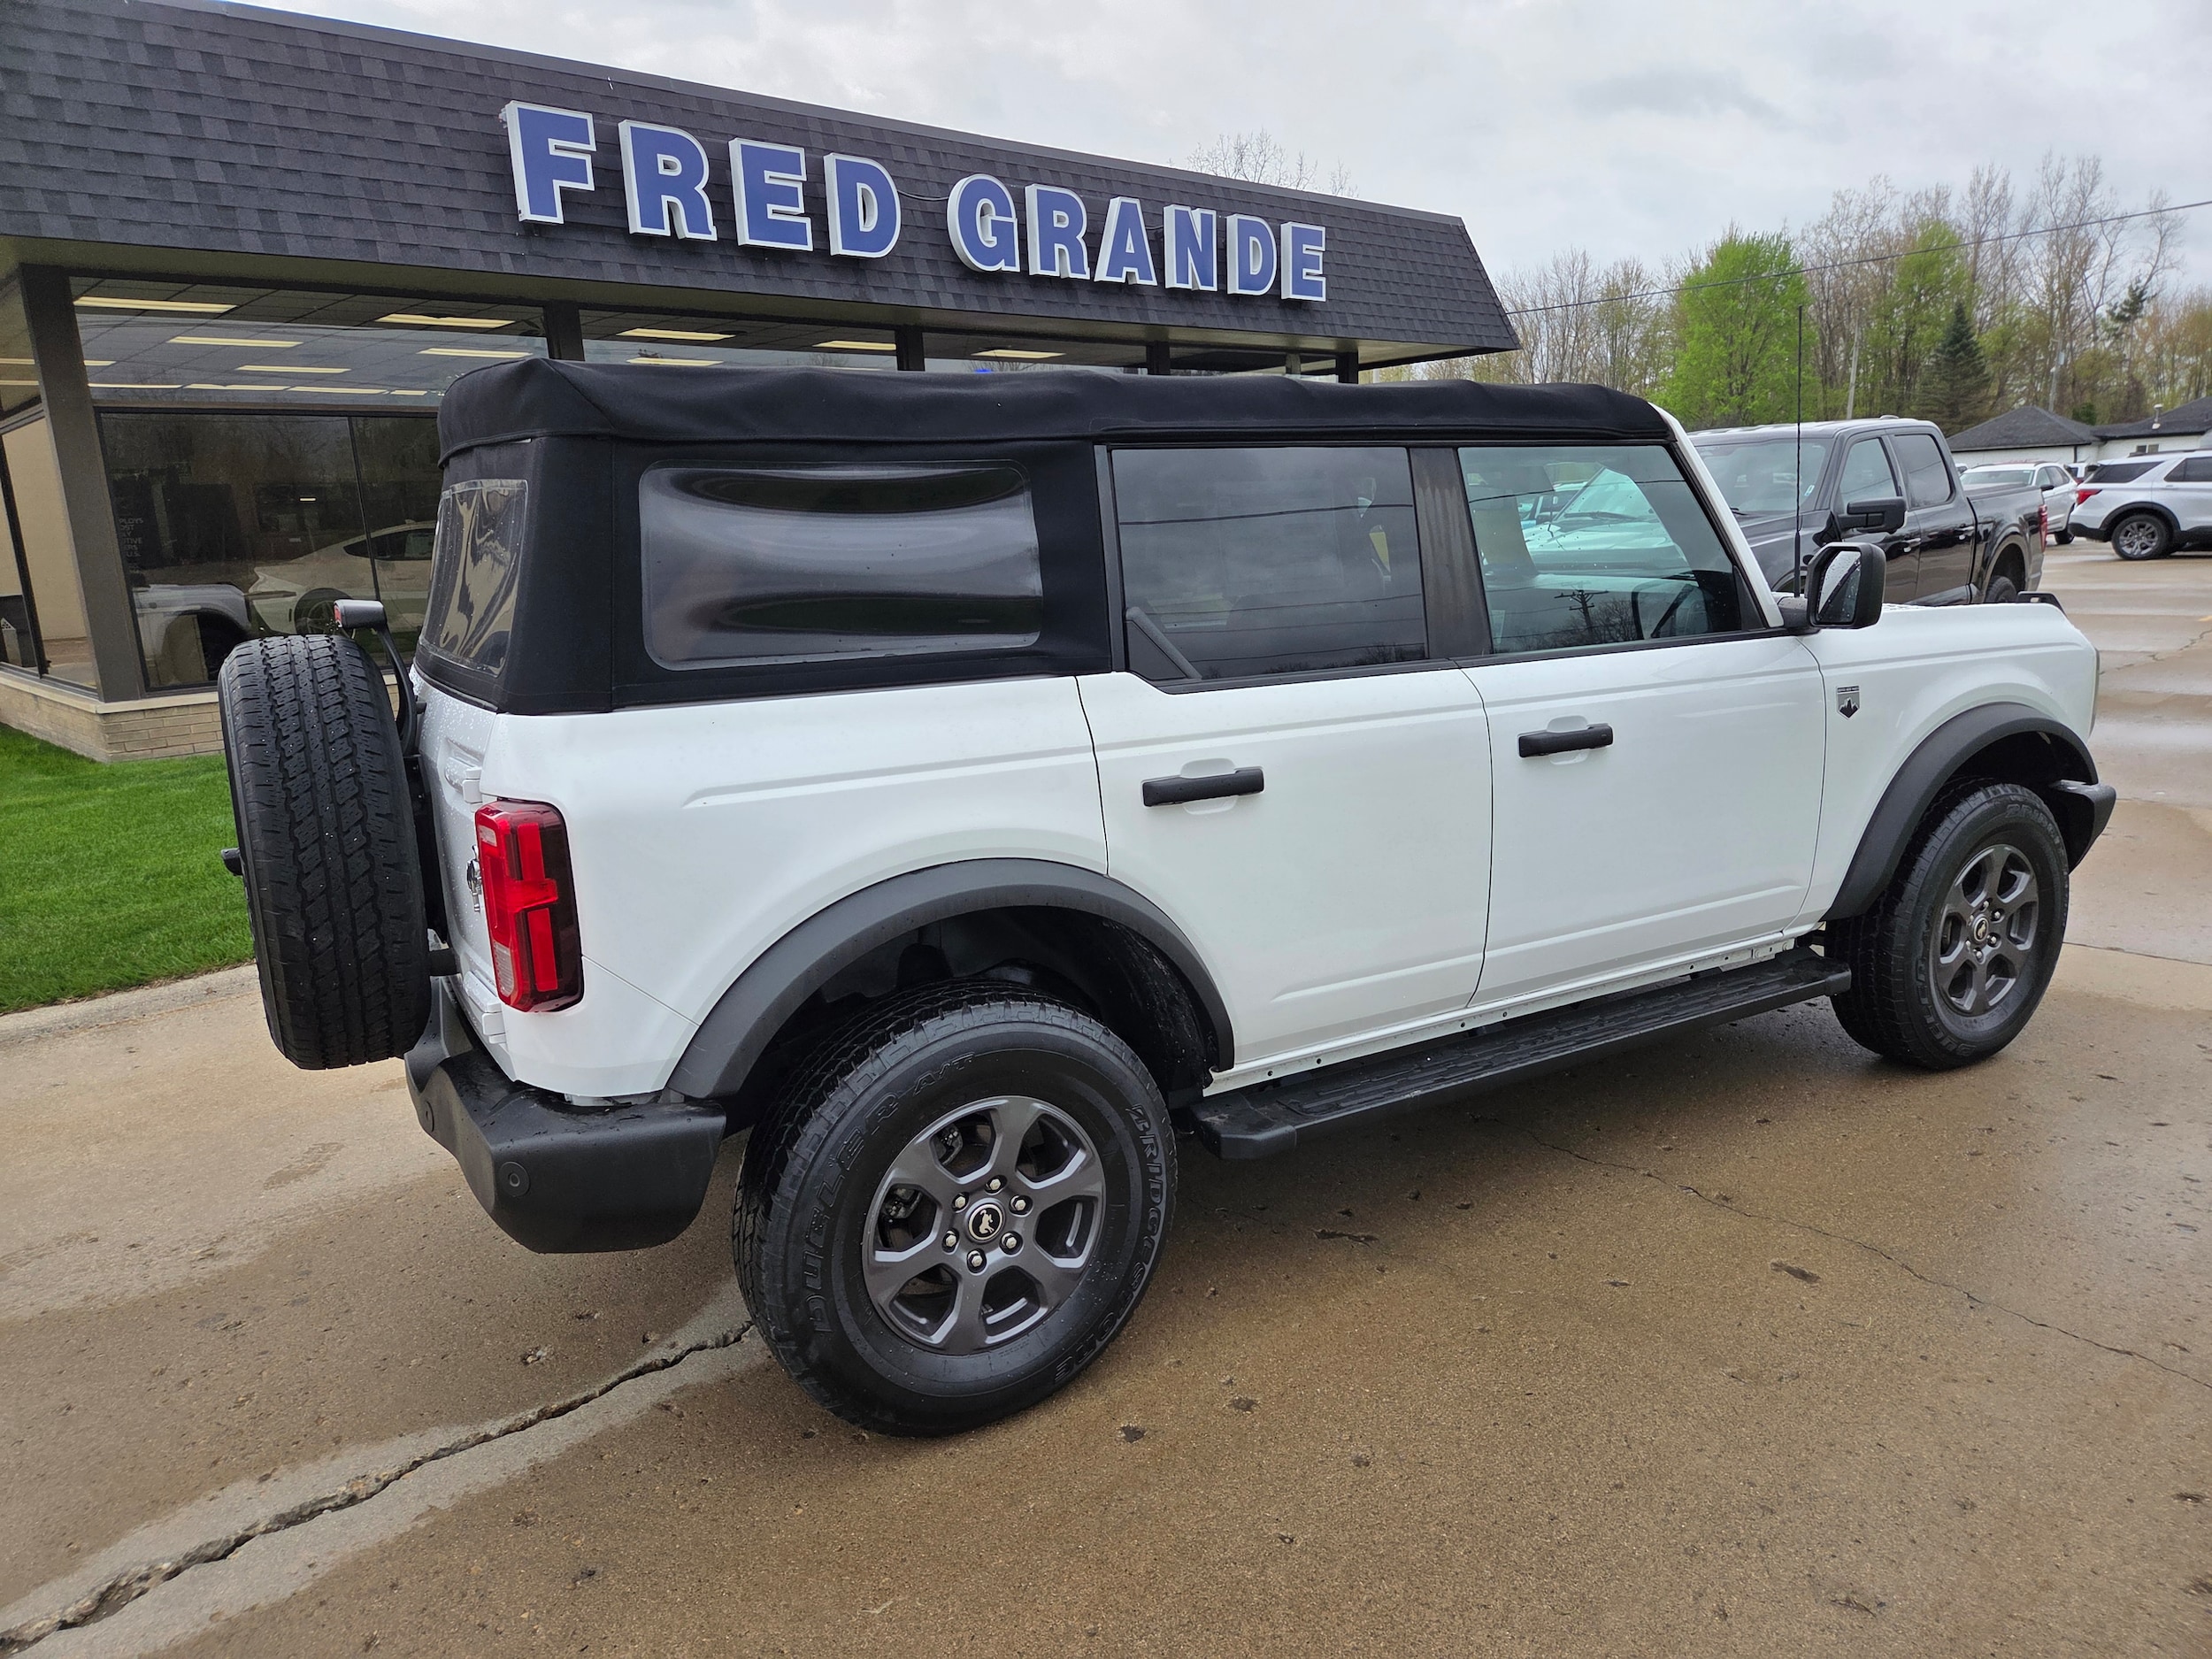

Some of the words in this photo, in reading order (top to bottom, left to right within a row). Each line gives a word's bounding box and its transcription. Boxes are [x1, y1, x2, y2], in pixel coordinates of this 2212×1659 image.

[505, 100, 902, 258] FRED
[947, 173, 1326, 302] GRANDE
[803, 1092, 900, 1333] DUELER
[1054, 1104, 1167, 1383] BRIDGESTONE
